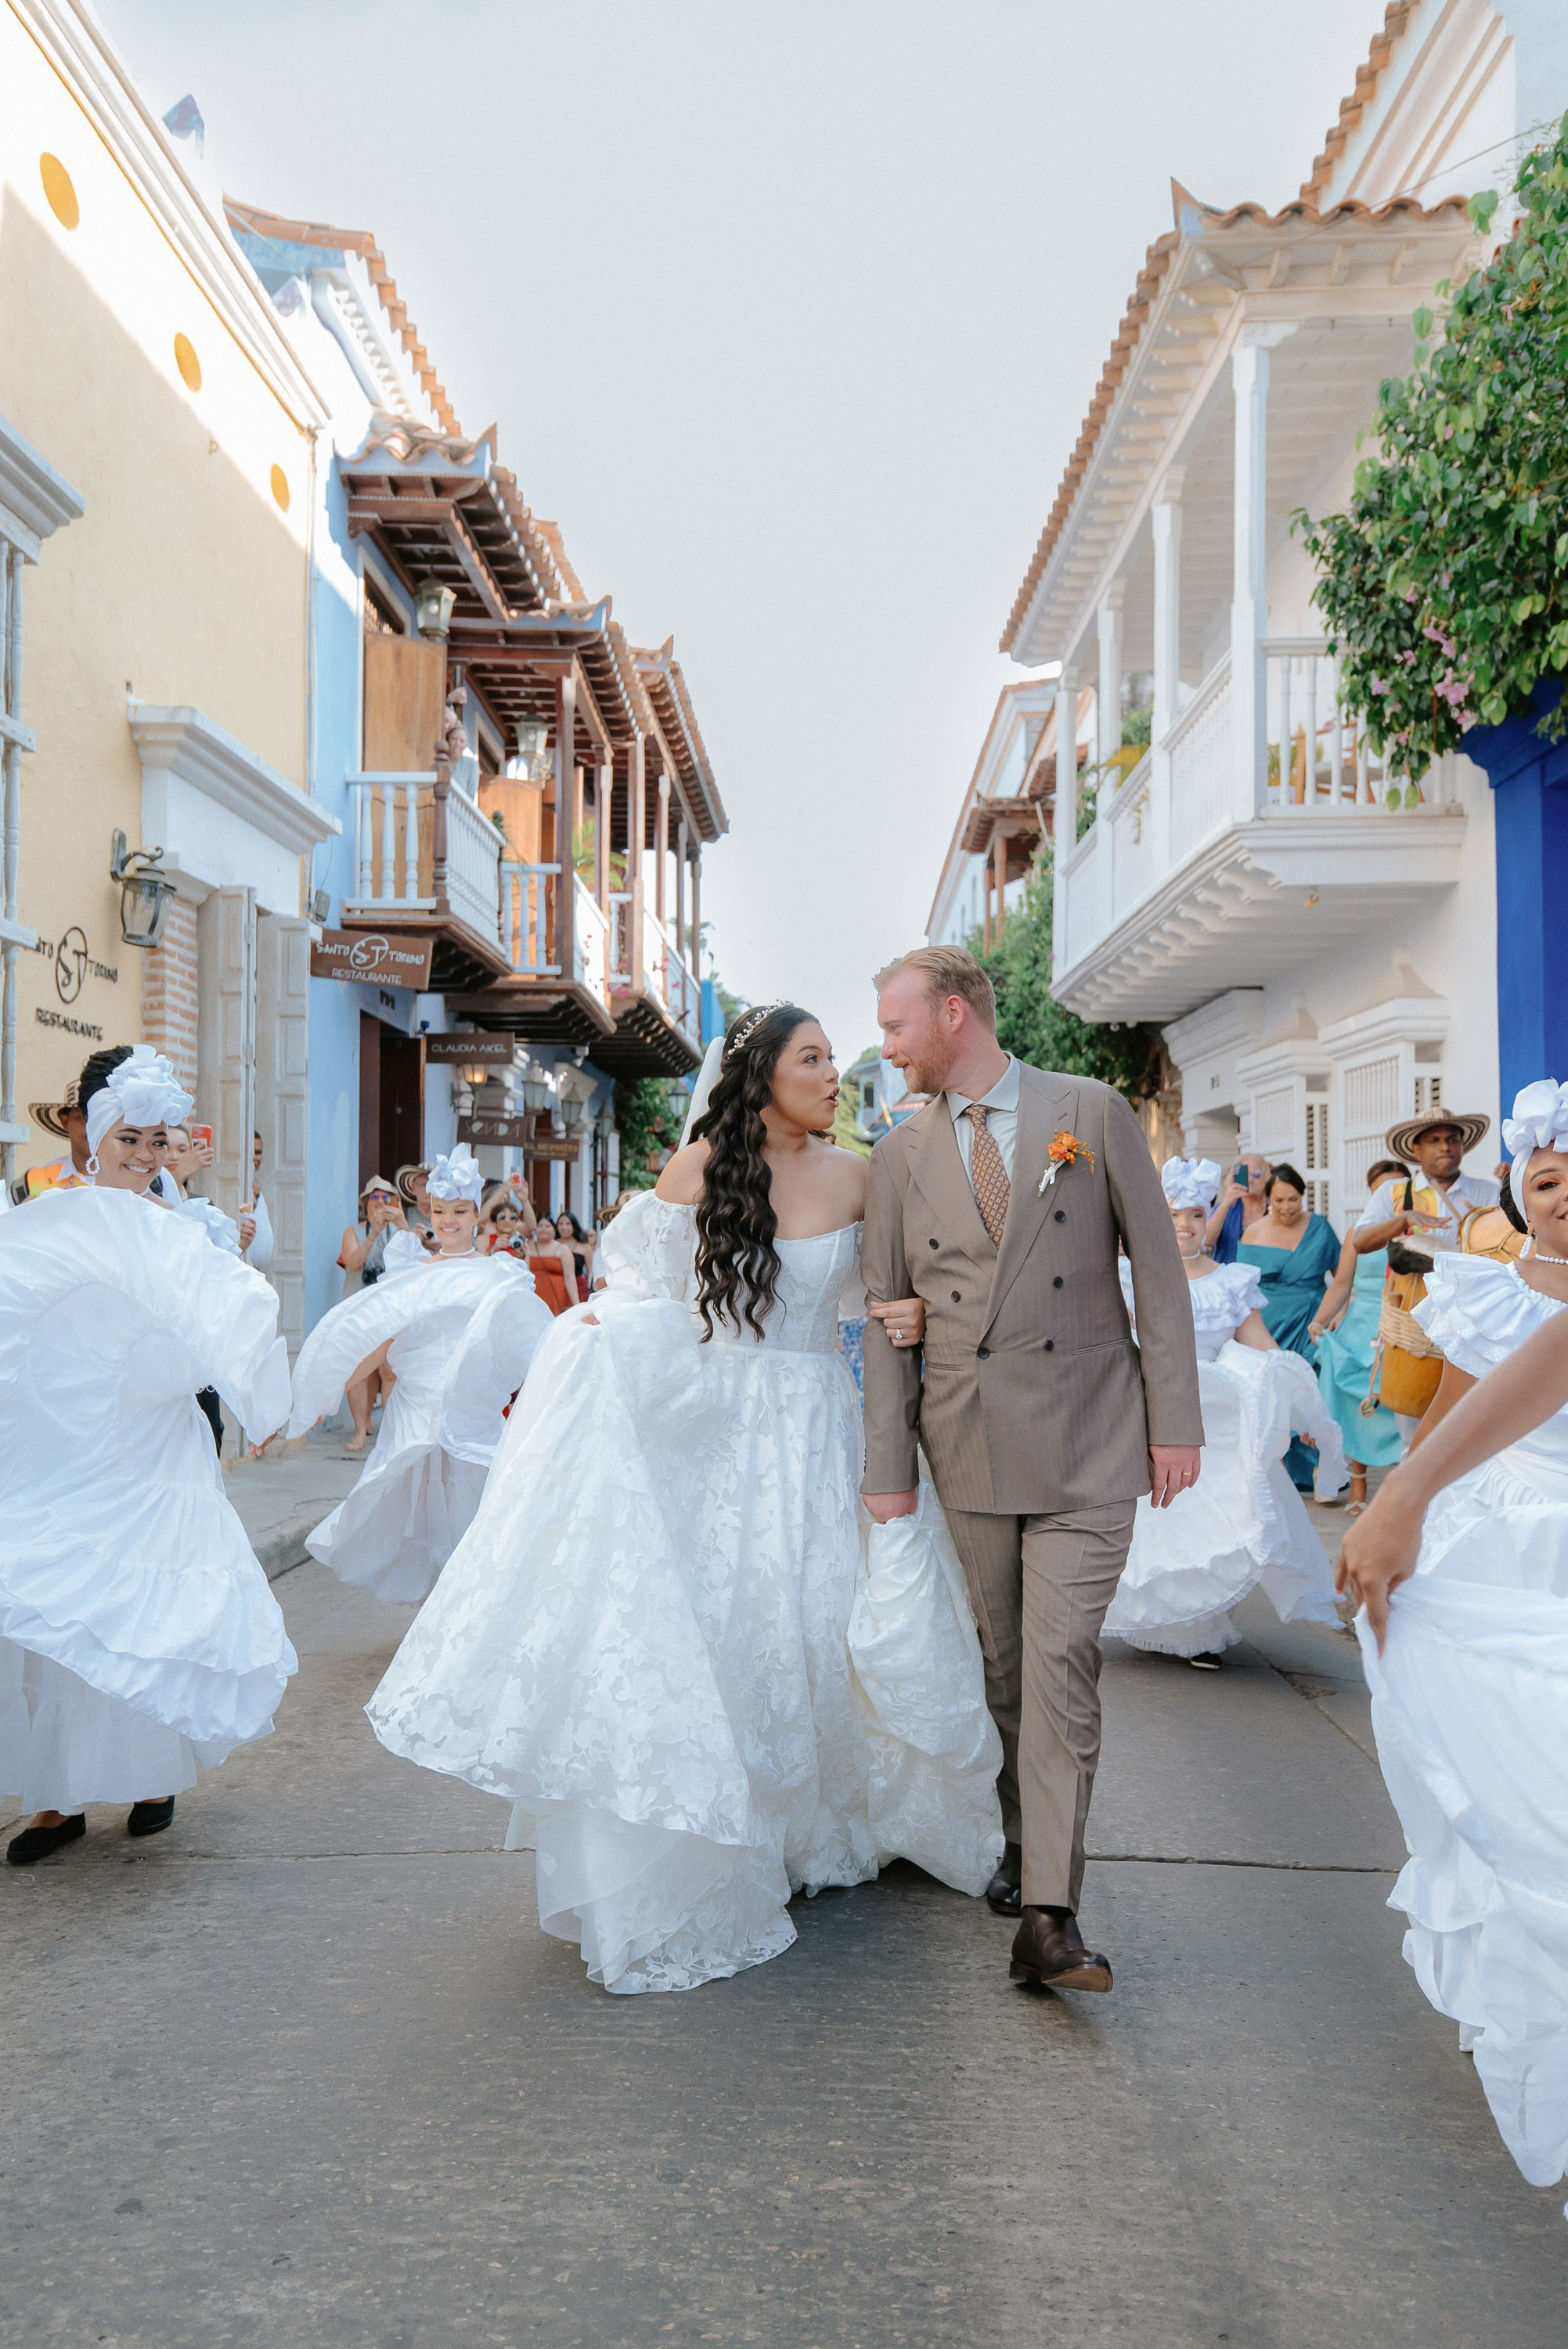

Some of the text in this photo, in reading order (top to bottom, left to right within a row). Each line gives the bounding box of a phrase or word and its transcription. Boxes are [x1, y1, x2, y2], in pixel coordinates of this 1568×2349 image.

[316, 940, 350, 956] SANTO
[332, 967, 402, 984] RESTAURANTE
[36, 1008, 103, 1041] RESTAURANTE
[431, 1043, 507, 1053] CLAUDIA AKEL
